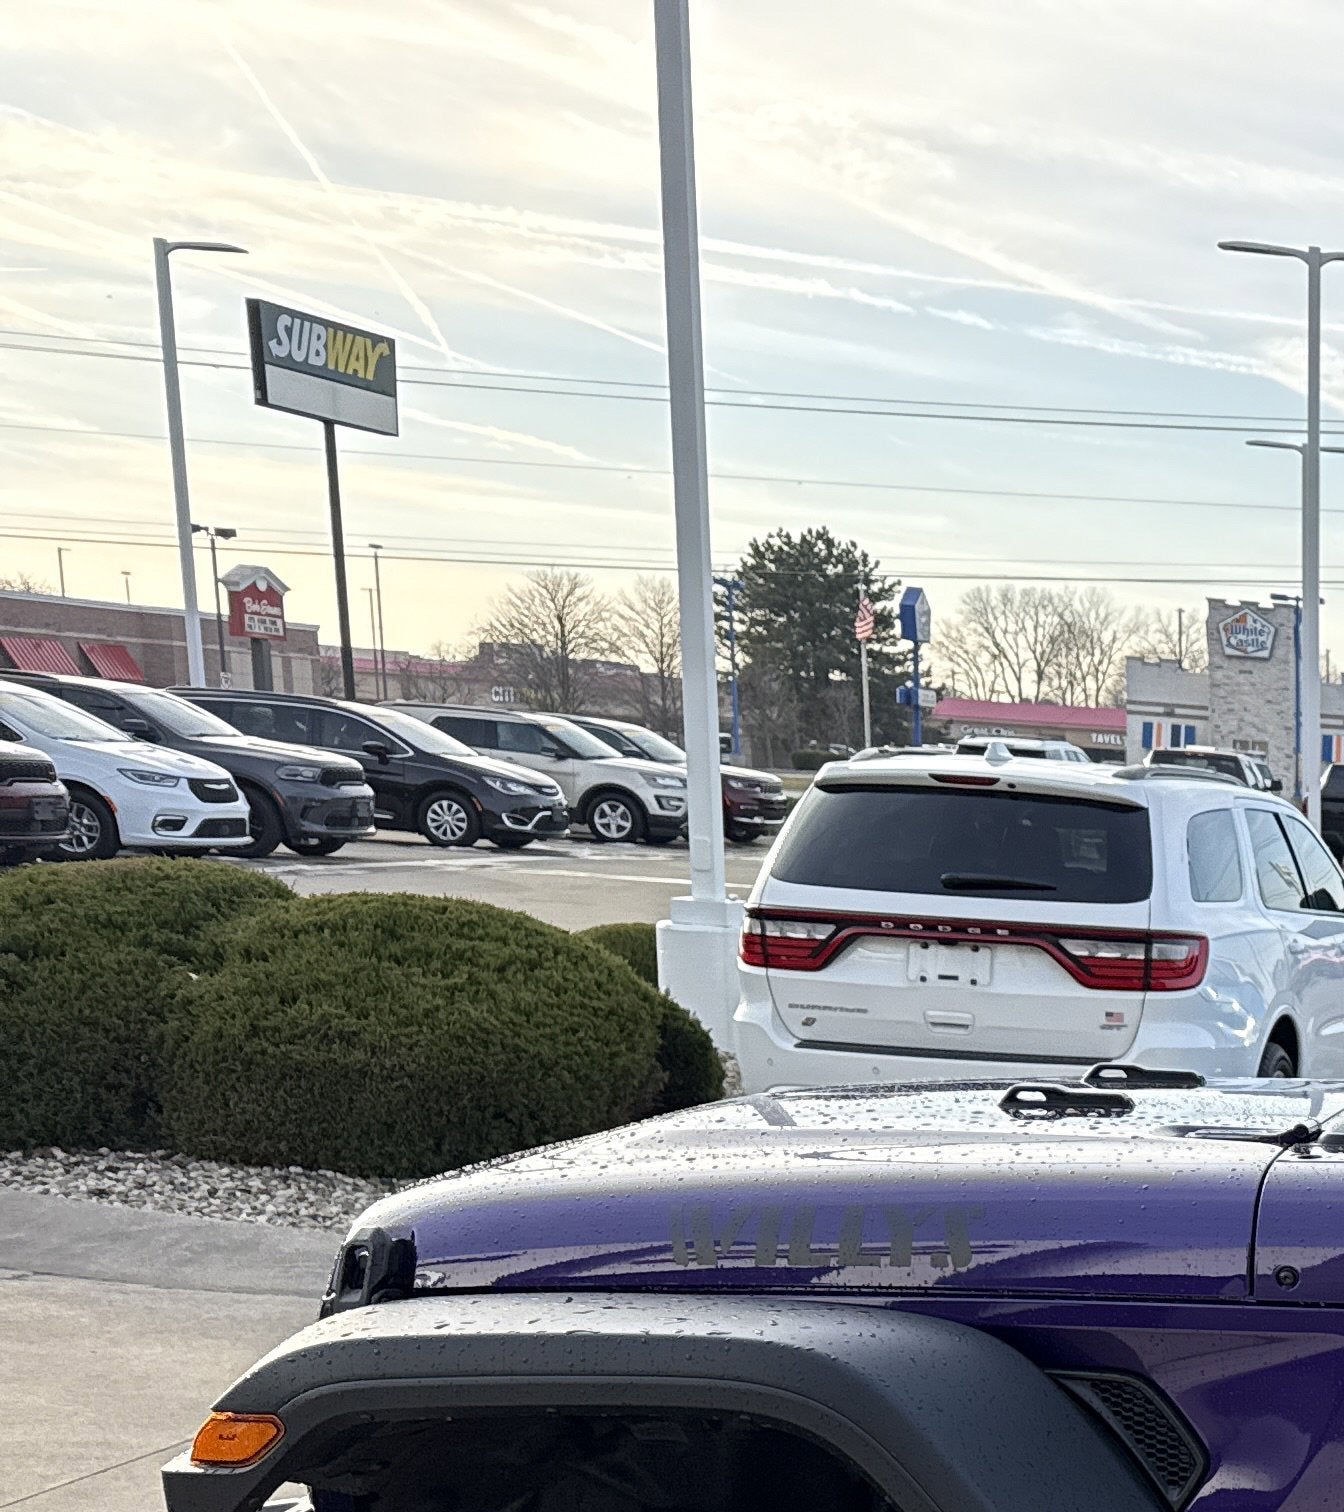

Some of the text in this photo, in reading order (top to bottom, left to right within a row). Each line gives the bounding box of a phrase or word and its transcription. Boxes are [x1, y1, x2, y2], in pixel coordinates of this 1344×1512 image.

[268, 313, 391, 382] SUBWAY
[878, 919, 1010, 935] DODGE
[669, 1201, 986, 1269] WILLYS
